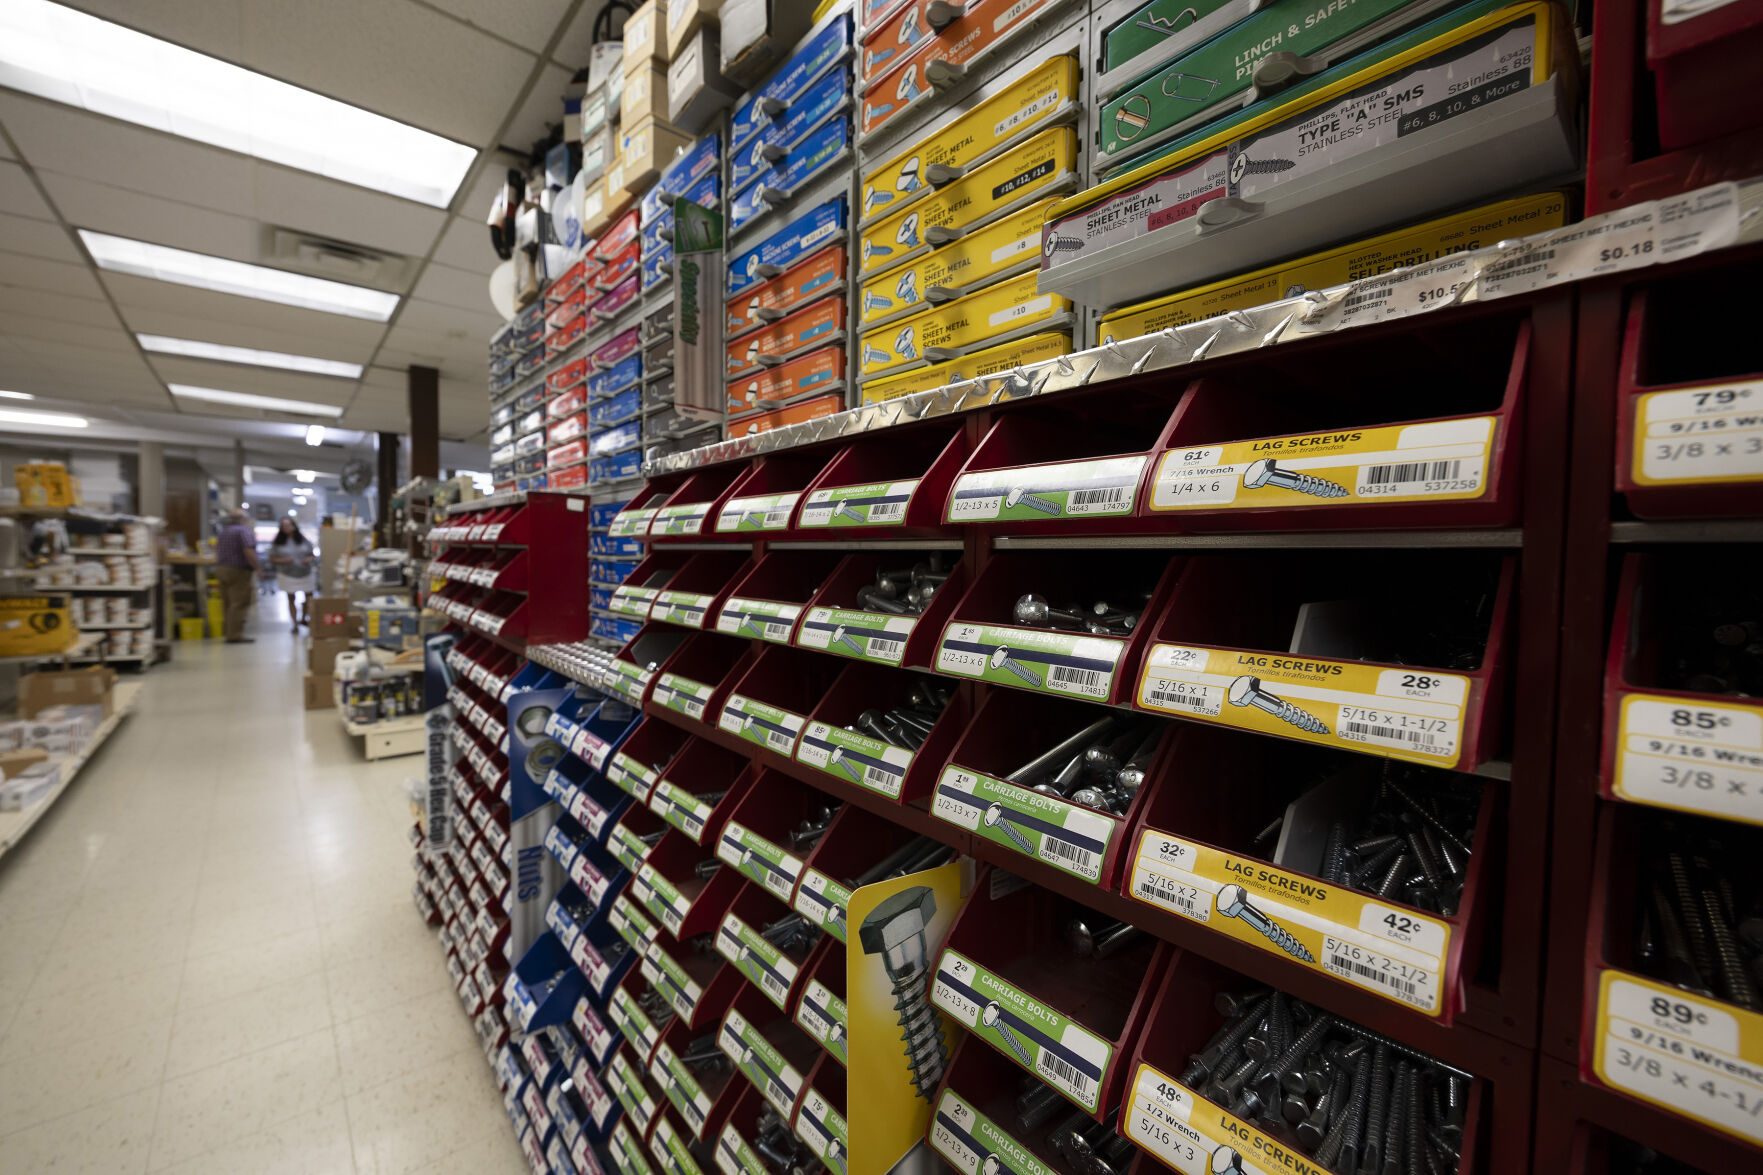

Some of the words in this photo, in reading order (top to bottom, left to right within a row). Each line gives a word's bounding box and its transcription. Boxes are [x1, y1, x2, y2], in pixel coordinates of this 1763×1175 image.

[1235, 32, 1282, 67] LINCH
[1288, 24, 1300, 38] &
[1500, 46, 1532, 63] 63420
[1447, 66, 1508, 97] Stainless
[1513, 55, 1532, 69] 88
[1298, 113, 1338, 131] PHILLIPS,
[1340, 101, 1361, 114] FLAT
[1364, 90, 1388, 108] HEAD
[1298, 118, 1341, 145] TYPE
[1346, 104, 1377, 128] "A"
[1383, 84, 1425, 111] SMS
[1403, 114, 1426, 132] #6,
[1428, 109, 1442, 123] 8,
[1446, 100, 1467, 115] 10,
[1471, 94, 1481, 105] &
[1486, 79, 1521, 99] More
[1298, 125, 1364, 158] STAINLESS
[1368, 107, 1408, 132] STEEL
[926, 149, 947, 167] SHEET
[950, 136, 974, 154] METAL
[1207, 170, 1226, 182] 63460
[1128, 194, 1140, 206] HEAD
[1177, 183, 1212, 202] Stainless
[1214, 177, 1226, 188] 86
[924, 209, 945, 226] SHEET
[948, 197, 972, 214] METAL
[1087, 209, 1120, 231] SHEET
[1124, 194, 1162, 219] METAL
[1087, 218, 1127, 239] STAINLESS
[1129, 208, 1154, 228] STEEL
[1470, 220, 1503, 236] Sheet
[1508, 209, 1541, 226] Metal
[1545, 203, 1562, 215] 20
[1550, 230, 1585, 246] SHEET
[1366, 253, 1398, 267] WASHER
[1400, 247, 1423, 258] HEAD
[1600, 240, 1654, 262] $0.18
[924, 267, 946, 283] SHEET
[947, 257, 972, 275] METAL
[1360, 281, 1388, 293] SCREW
[1389, 272, 1414, 286] SHEET
[1417, 268, 1434, 280] MET
[680, 258, 700, 346] Specialty
[1220, 289, 1242, 301] Sheet
[1244, 282, 1265, 295] Metal
[922, 328, 944, 342] SHEET
[946, 318, 969, 333] METAL
[923, 334, 951, 348] SCREWS
[977, 365, 997, 377] SHEET
[1000, 359, 1024, 372] METAL
[1670, 420, 1727, 434] 9/16
[1253, 440, 1283, 451] LAG
[1289, 432, 1362, 449] SCREWS
[1262, 448, 1298, 458] Tornillos
[1299, 443, 1345, 455] tirafondos
[1656, 442, 1704, 461] 3/8
[1170, 469, 1194, 479] 7/16
[1196, 465, 1234, 476] Wrench
[1172, 483, 1193, 495] 1/4
[1211, 480, 1220, 492] 6
[1358, 484, 1397, 495] 04314
[1425, 479, 1477, 491] 537258
[954, 500, 982, 512] 1/2-13
[1067, 504, 1089, 513] 04643
[1102, 501, 1130, 511] 174797
[942, 652, 969, 664] 1/2-13
[1238, 655, 1268, 667] LAG
[1271, 659, 1344, 676] SCREWS
[1158, 679, 1185, 693] 5/16
[1247, 667, 1281, 678] Tornillos
[1282, 670, 1327, 682] tirafondos
[1400, 674, 1441, 691] 28¢
[1047, 680, 1068, 690] 04645
[1080, 685, 1106, 696] 174813
[1405, 689, 1431, 698] EACH
[1144, 698, 1164, 707] 04315
[1193, 706, 1219, 717] 537266
[1342, 707, 1378, 724] 5/16
[1400, 716, 1448, 734] 1-1/2
[429, 732, 449, 774] Grade
[833, 731, 862, 744] CARRIAGE
[863, 739, 883, 751] BOLTS
[1338, 730, 1367, 742] 04316
[1411, 742, 1451, 757] 378372
[1650, 740, 1706, 757] 9/16
[1660, 765, 1715, 790] 3/8
[429, 787, 448, 812] Hex
[937, 798, 963, 815] 1/2-13
[983, 781, 1028, 803] CARRIAGE
[1029, 794, 1062, 814] BOLTS
[429, 813, 449, 843] Cap
[1159, 840, 1185, 857] 32¢
[1159, 853, 1176, 863] EACH
[517, 846, 543, 901] Nuts
[1039, 849, 1060, 863] 04647
[1071, 863, 1097, 878] 174839
[1148, 872, 1176, 889] 5/16
[1225, 859, 1255, 878] LAG
[1257, 868, 1327, 901] SCREWS
[1234, 874, 1267, 890] Tornillos
[1267, 884, 1311, 906] tirafondos
[1135, 889, 1154, 901] 04317
[1182, 906, 1208, 922] 378380
[1383, 913, 1422, 933] 42¢
[1387, 929, 1412, 943] EACH
[1325, 938, 1361, 960] 5/16
[1382, 957, 1429, 985] 2-1/2
[936, 985, 962, 1007] 1/2-13
[1323, 961, 1351, 978] 04318
[1393, 989, 1433, 1010] 378398
[981, 975, 1026, 1007] CARRIAGE
[1028, 1001, 1059, 1026] BOLTS
[1630, 1027, 1683, 1055] 9/16
[1037, 1063, 1057, 1081] 04649
[1616, 1047, 1663, 1078] 3/8
[1156, 1082, 1182, 1102] 48¢
[1156, 1096, 1172, 1110] EACH
[1146, 1103, 1163, 1119] 1/2
[1165, 1115, 1201, 1142] Wrench
[1221, 1116, 1250, 1141] LAG
[936, 1127, 961, 1154] 1/2-13
[981, 1123, 1027, 1164] CARRIAGE
[1140, 1118, 1170, 1146] 5/16
[1186, 1147, 1194, 1161] 3
[1230, 1135, 1261, 1160] Tornillos
